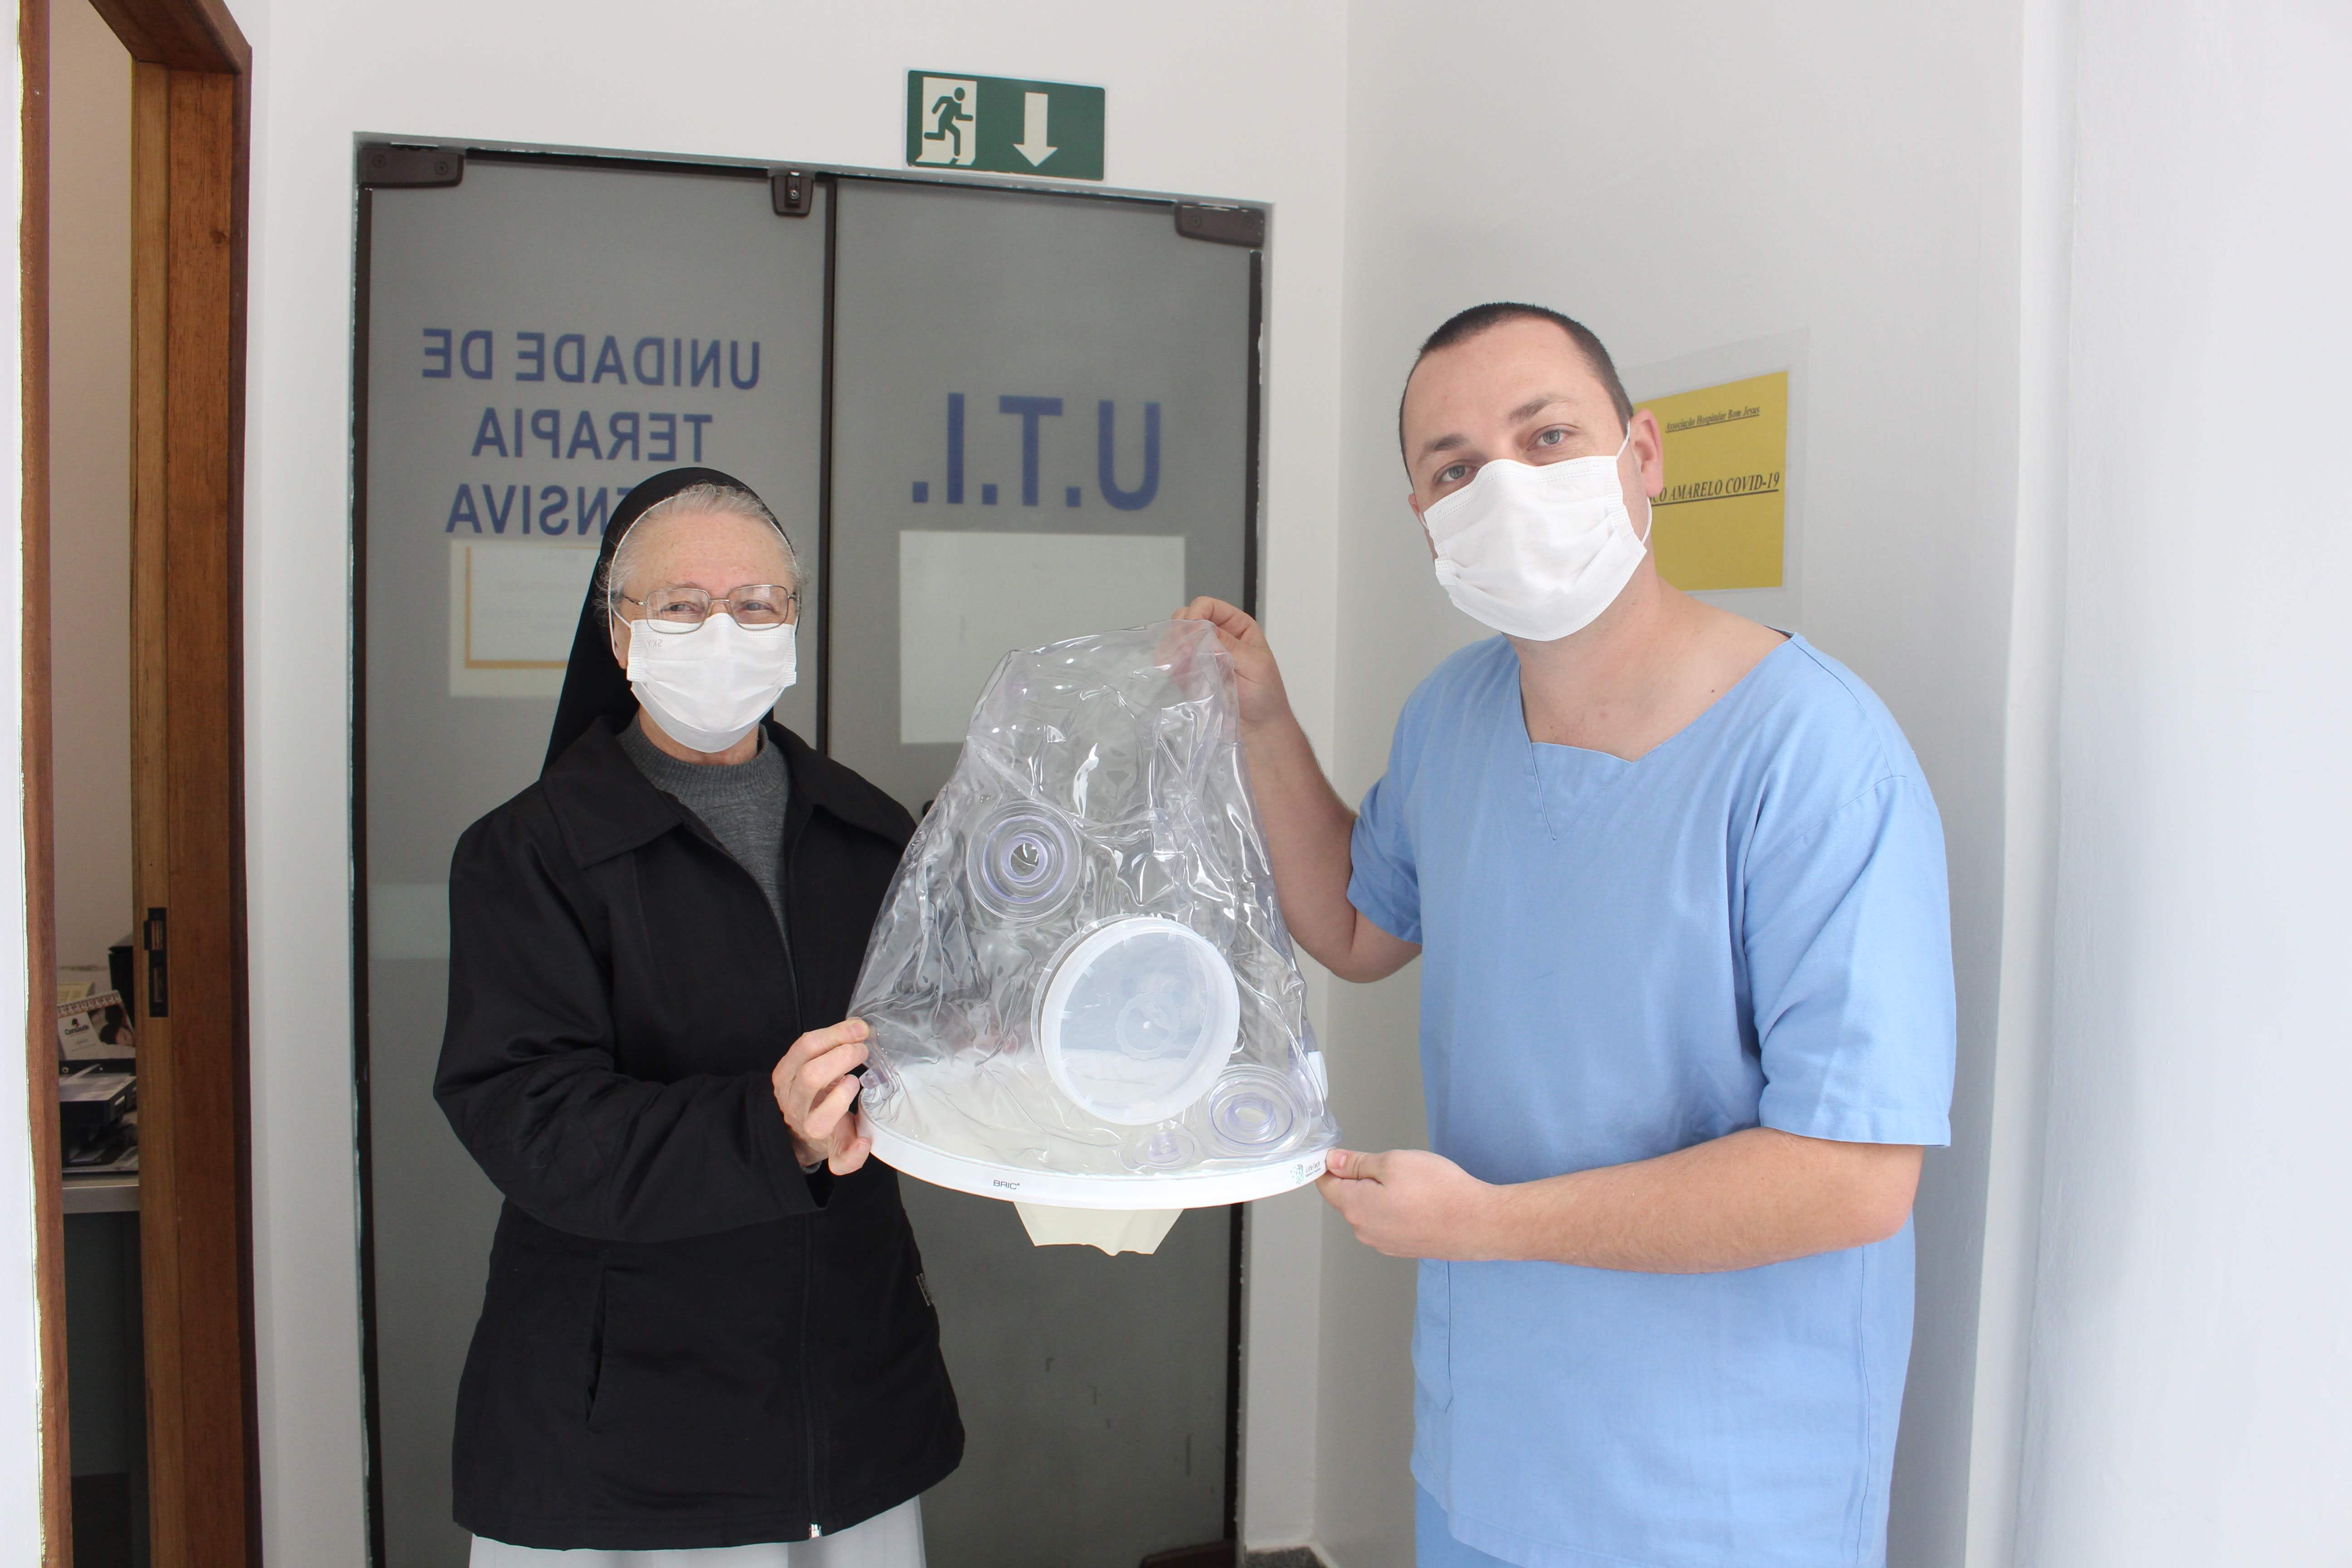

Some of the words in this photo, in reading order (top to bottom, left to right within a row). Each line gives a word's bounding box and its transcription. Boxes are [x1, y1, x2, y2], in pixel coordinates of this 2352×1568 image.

[1728, 409, 1741, 419] Bom
[1743, 406, 1760, 416] Jesus
[1668, 480, 1723, 501] AMARELO
[1725, 471, 1780, 494] COVID-19
